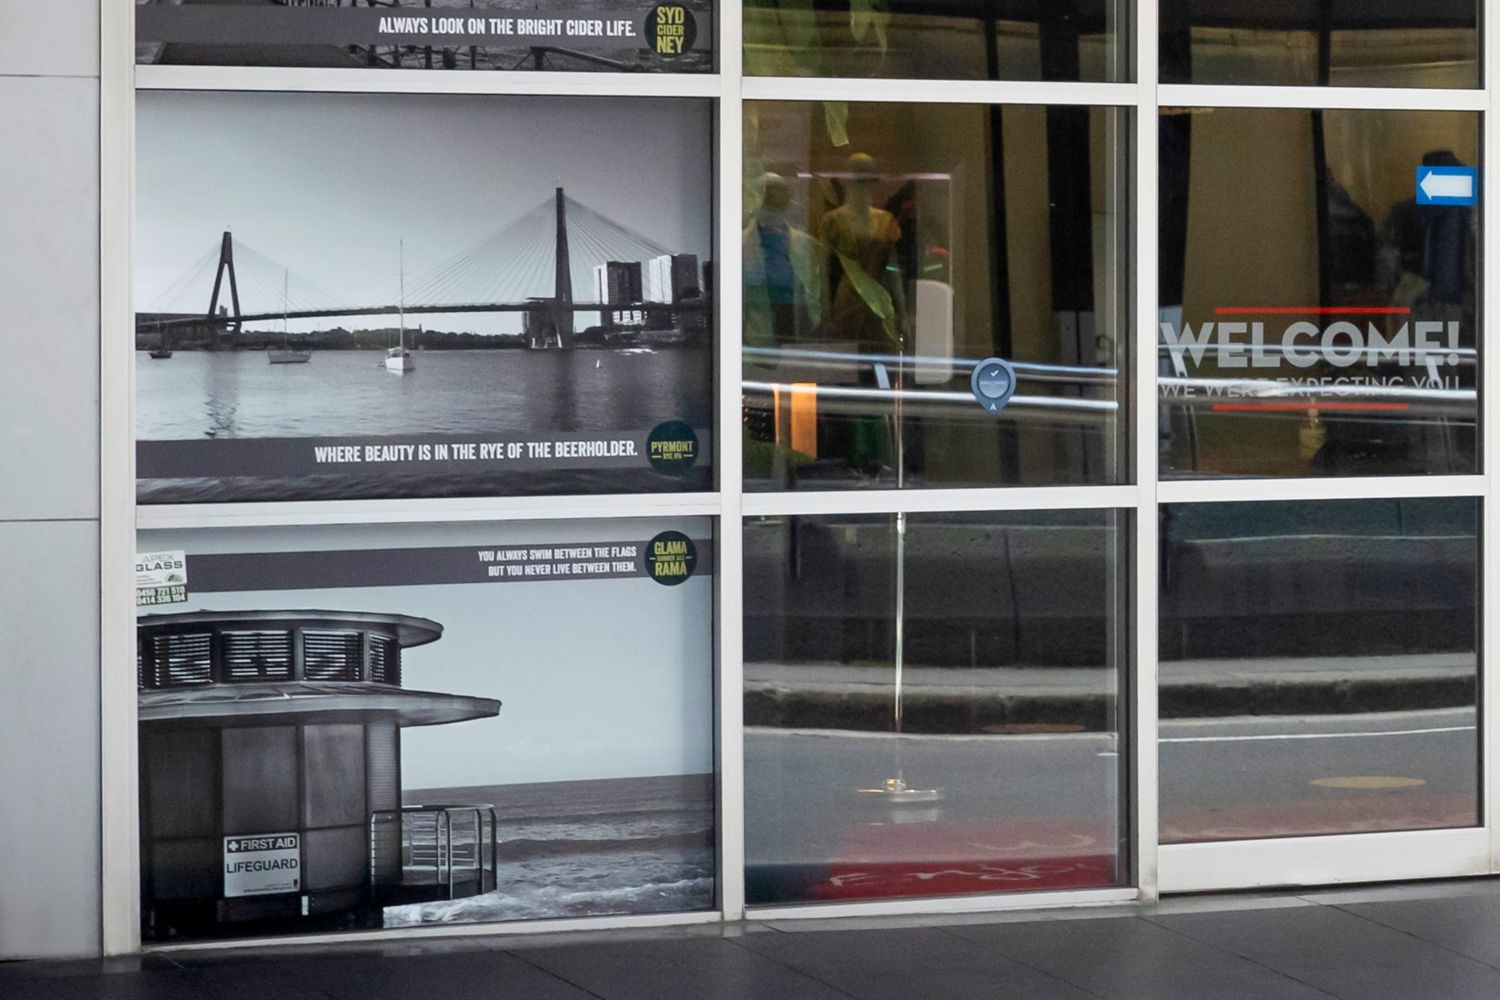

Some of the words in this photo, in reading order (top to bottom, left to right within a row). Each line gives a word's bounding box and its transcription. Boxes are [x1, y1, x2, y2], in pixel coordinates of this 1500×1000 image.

[657, 6, 685, 24] SYD
[378, 17, 428, 34] ALWAYS
[432, 17, 464, 34] LOOK
[468, 18, 486, 35] ON
[489, 18, 514, 35] THE
[517, 19, 563, 35] BRIGHT
[566, 19, 603, 36] CIDER
[606, 20, 636, 36] LIFE.
[657, 25, 684, 36] CIDER
[657, 36, 684, 53] NEY
[1159, 321, 1460, 368] WELCOME!
[1160, 379, 1197, 398] WE
[315, 446, 361, 463] WHERE
[364, 445, 415, 462] BEAUTY
[418, 444, 431, 461] IS
[434, 444, 448, 460] IN
[452, 443, 476, 460] THE
[480, 443, 504, 459] RYE
[507, 442, 523, 459] OF
[527, 441, 551, 458] THE
[555, 440, 638, 458] BEERHOLDER.
[651, 441, 693, 452] PYRMONT
[478, 551, 495, 562] YOU
[496, 550, 528, 561] ALWAYS
[529, 549, 552, 560] SWIM
[554, 548, 592, 560] BETWEEN
[594, 547, 610, 558] THE
[611, 546, 637, 558] FLAGS
[655, 541, 687, 554] GLAMA
[143, 553, 175, 563] APEX
[136, 561, 183, 572] GLASS
[488, 566, 504, 577] BUT
[506, 565, 523, 576] YOU
[524, 564, 551, 576] NEVER
[552, 564, 570, 574] LIVE
[572, 562, 610, 574] BETWEEN
[612, 562, 637, 572] THEM.
[655, 561, 687, 576] RAMA
[241, 839, 275, 851] FIRST
[275, 837, 296, 848] AID
[227, 858, 298, 873] LIFEGUARD
